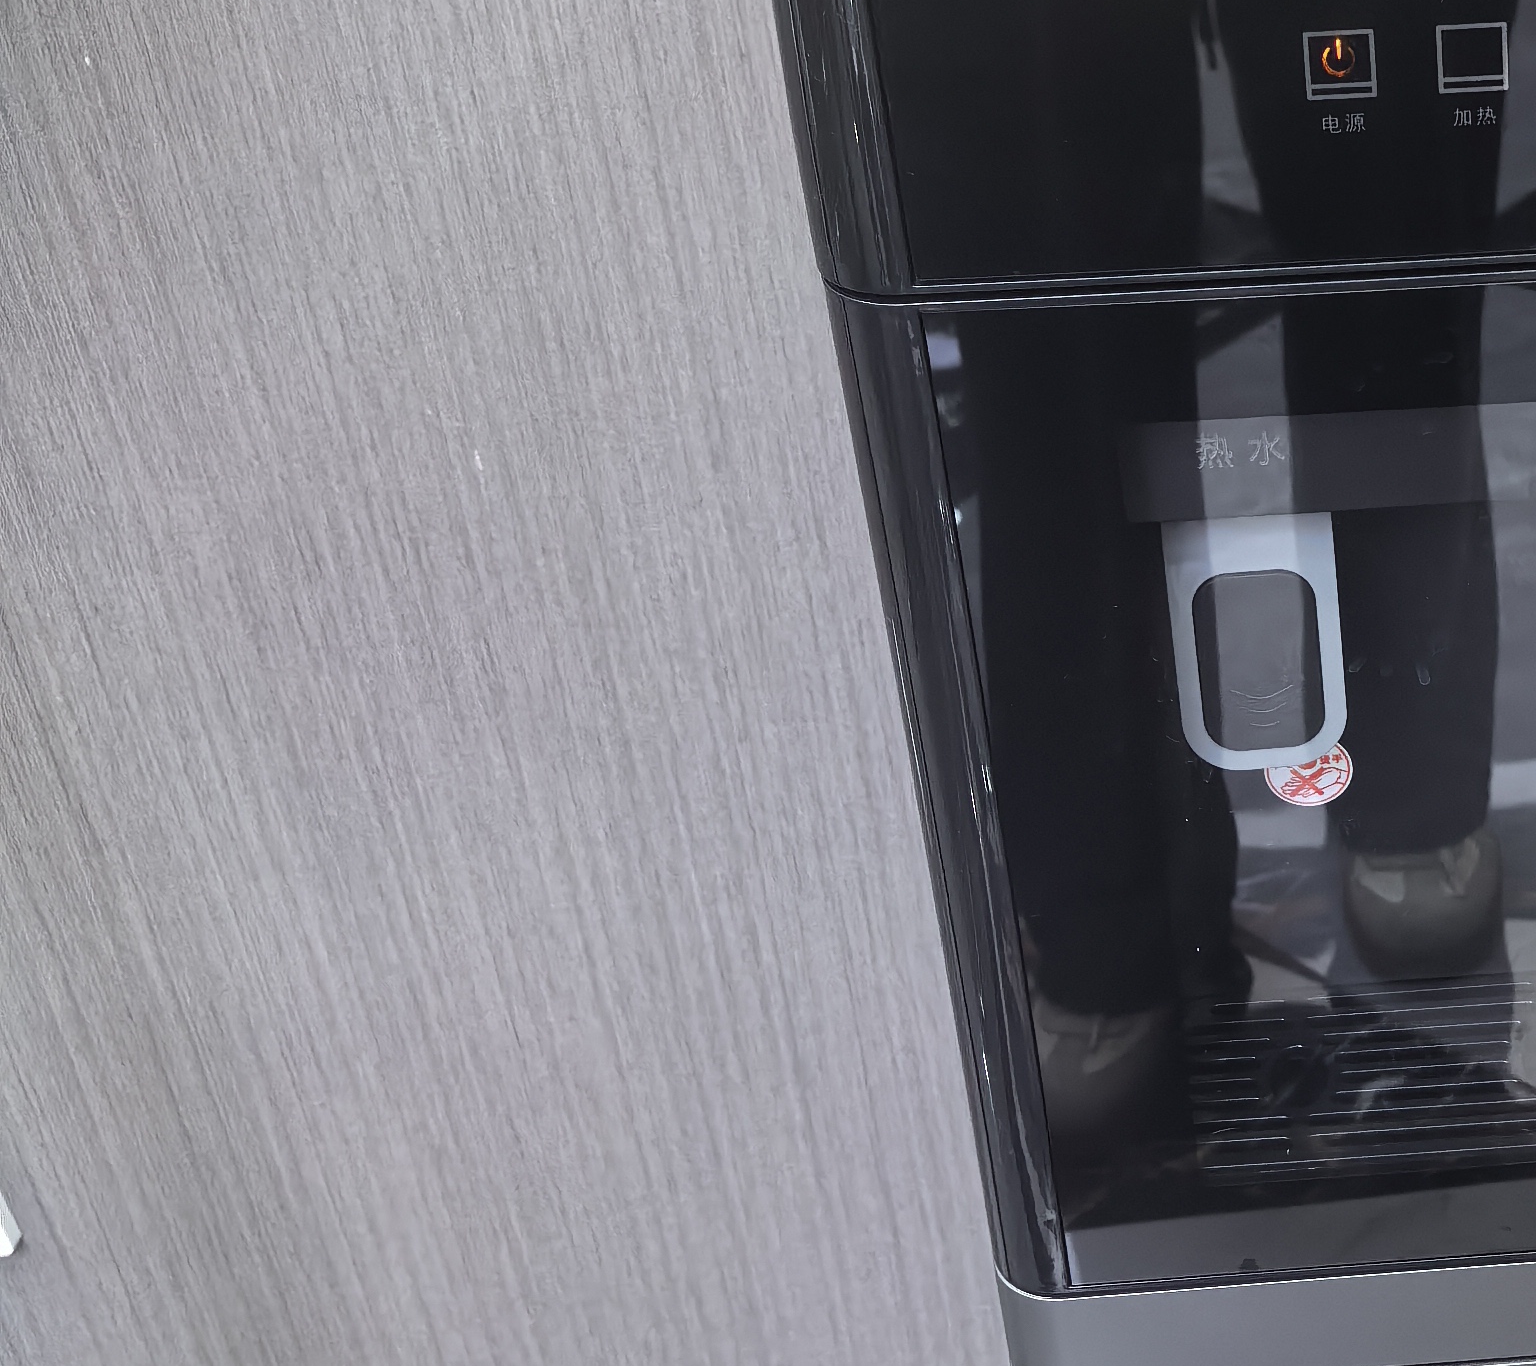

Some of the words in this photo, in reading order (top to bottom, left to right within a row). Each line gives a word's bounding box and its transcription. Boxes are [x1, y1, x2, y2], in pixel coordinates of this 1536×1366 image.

[1321, 112, 1367, 134] 电源
[1453, 106, 1498, 127] 加热
[1196, 431, 1286, 471] 热水
